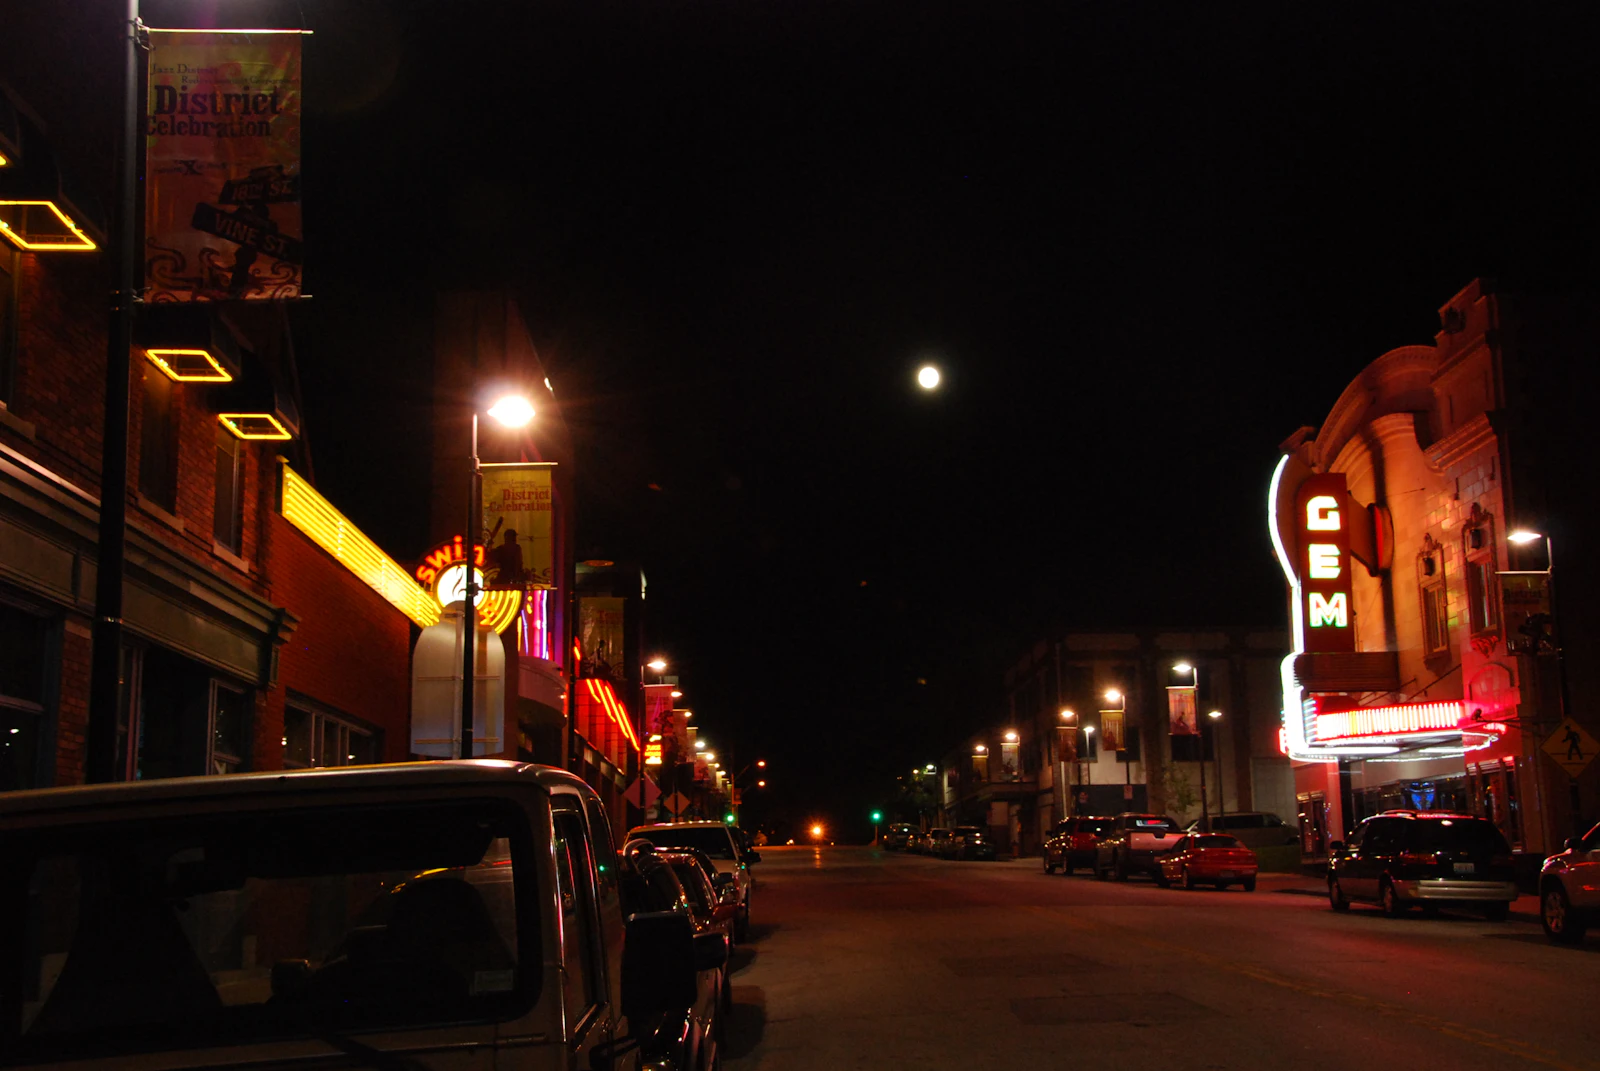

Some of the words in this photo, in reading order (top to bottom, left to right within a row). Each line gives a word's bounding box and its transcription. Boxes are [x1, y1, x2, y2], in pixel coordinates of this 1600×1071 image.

[153, 84, 283, 115] District
[146, 114, 271, 138] Celebration
[215, 213, 260, 244] VINE
[489, 500, 552, 513] Celebration
[503, 488, 550, 503] District
[1306, 496, 1348, 629] GEM
